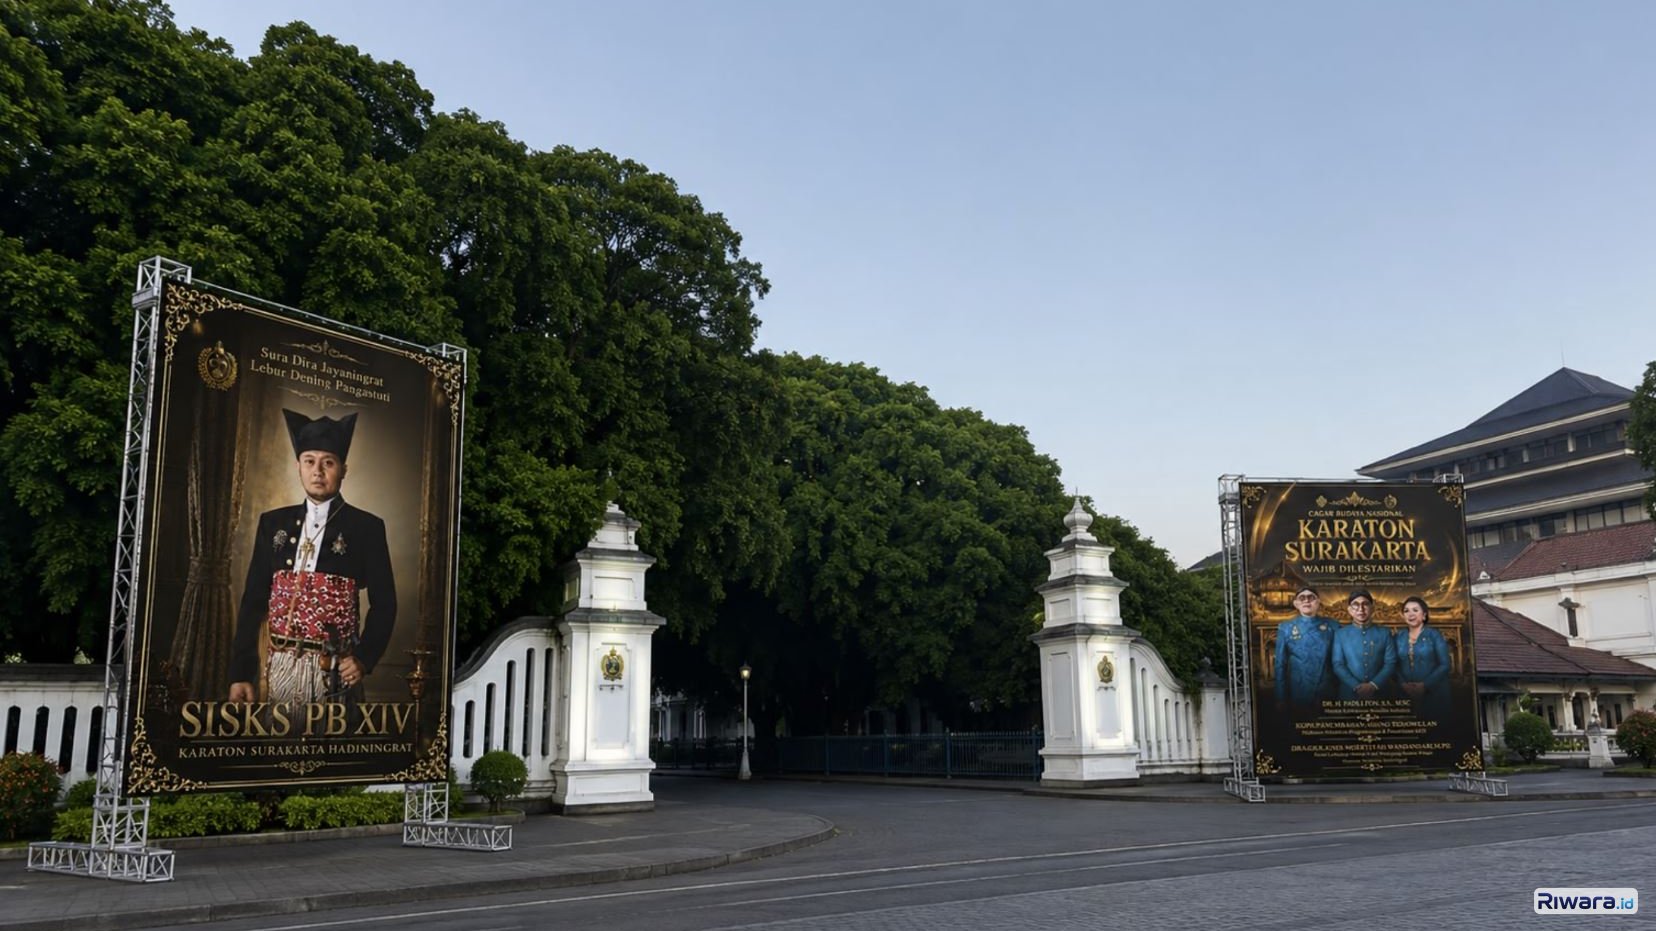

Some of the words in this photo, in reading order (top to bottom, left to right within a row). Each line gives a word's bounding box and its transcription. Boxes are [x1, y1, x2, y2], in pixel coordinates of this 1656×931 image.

[260, 346, 288, 364] Sura
[292, 354, 317, 371] Dira
[320, 361, 384, 387] Jayaningrat
[250, 359, 287, 377] Lebur
[290, 369, 332, 390] Dening
[335, 379, 391, 402] Pangastuti
[1298, 519, 1415, 539] KARATON
[1285, 540, 1431, 561] SURAKARTA
[1303, 565, 1336, 573] WAJIB
[1339, 565, 1416, 573] DILESTARIKAN
[179, 701, 291, 738] SISKS
[301, 702, 347, 736] PB
[354, 702, 415, 735] XIV
[178, 746, 246, 759] KARATON
[250, 744, 325, 757] SURAKARTA
[329, 742, 413, 755] HADININGRAT
